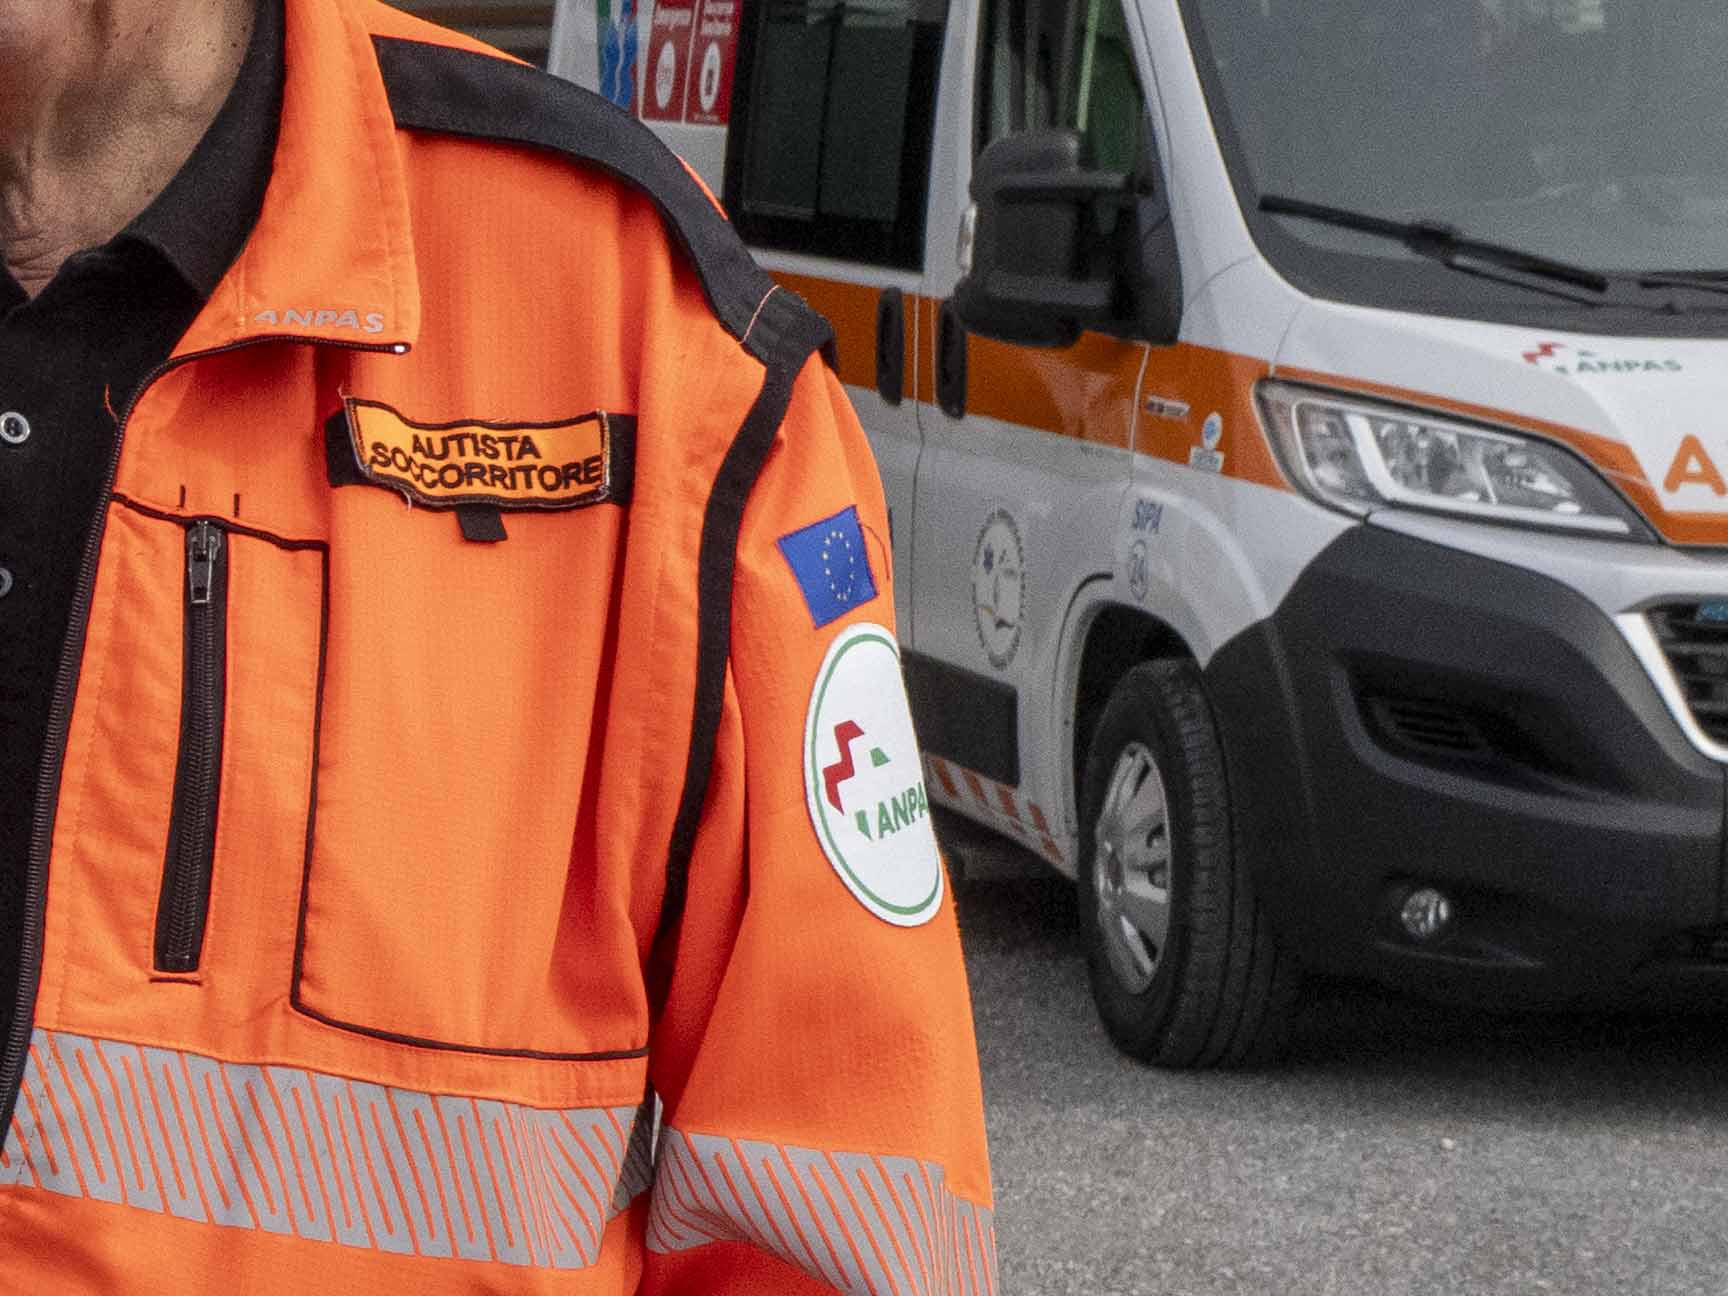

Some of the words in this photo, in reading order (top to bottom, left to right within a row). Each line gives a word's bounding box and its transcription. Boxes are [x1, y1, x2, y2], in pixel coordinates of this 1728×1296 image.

[254, 308, 385, 334] ANPAS
[412, 433, 542, 462] AUTISTA
[370, 441, 602, 492] SOCCORRITORE
